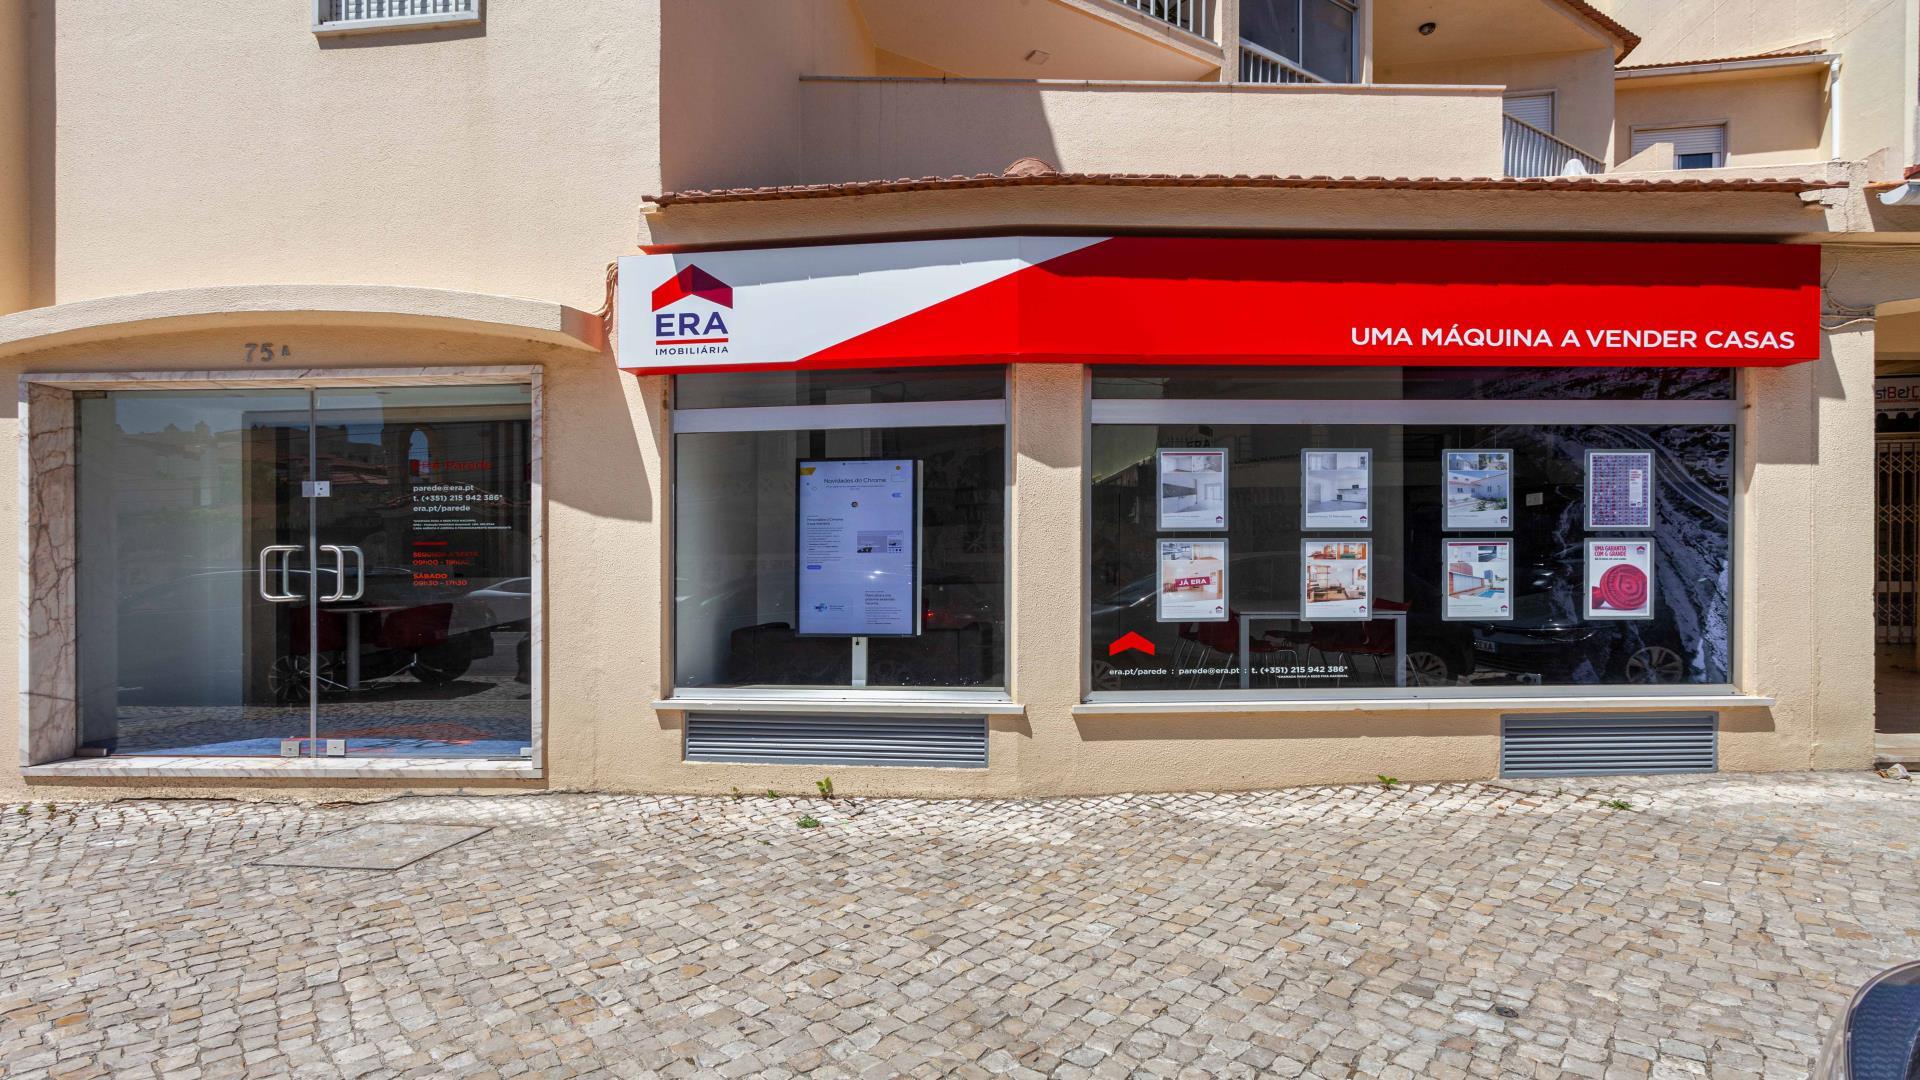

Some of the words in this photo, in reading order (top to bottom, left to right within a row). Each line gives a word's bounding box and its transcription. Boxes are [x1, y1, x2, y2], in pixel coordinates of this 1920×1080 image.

[655, 311, 729, 337] ERA
[1351, 327, 1413, 346] UMA
[1421, 323, 1553, 347] MÁQUINA
[1560, 329, 1581, 347] A
[1585, 329, 1698, 348] VENDER
[1704, 330, 1796, 349] CASAS
[244, 342, 274, 362] 75
[655, 345, 729, 356] IMOBILIÁRIA
[413, 484, 474, 492] parede@era.pt
[1179, 578, 1189, 586] JÁ
[1109, 667, 1167, 676] era.pt/parede
[1178, 667, 1240, 676] parede@era.pt
[1260, 666, 1288, 675] (+351)
